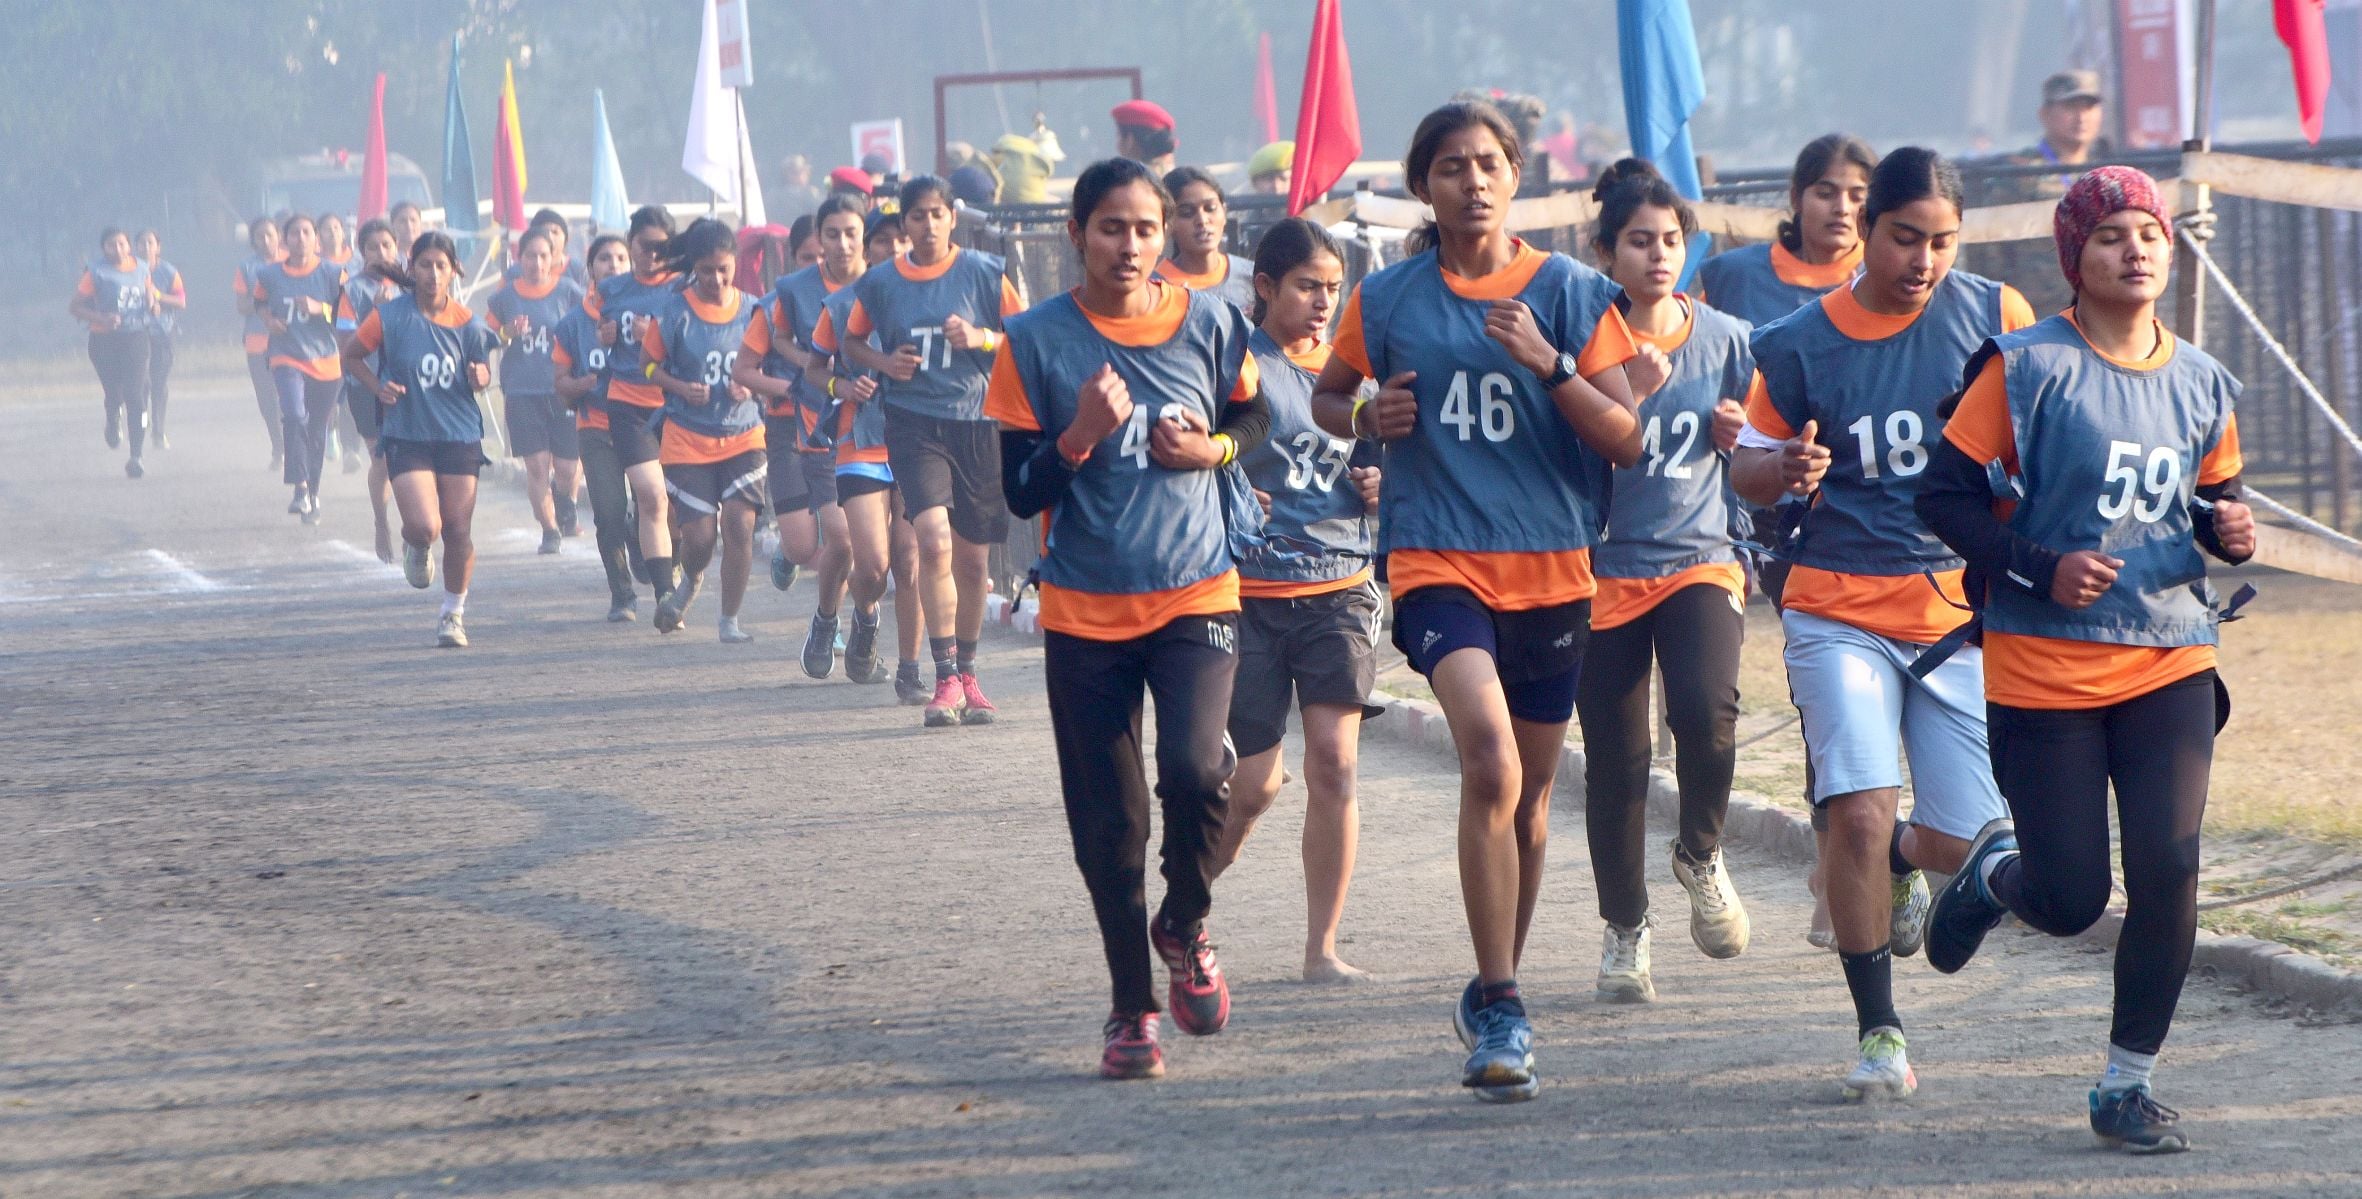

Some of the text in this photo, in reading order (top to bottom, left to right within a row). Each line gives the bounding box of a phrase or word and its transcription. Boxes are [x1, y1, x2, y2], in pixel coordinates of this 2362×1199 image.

[421, 352, 456, 389] 98
[910, 326, 953, 371] 77
[1439, 370, 1515, 443] 46
[1288, 431, 1350, 493] 35
[1642, 410, 1699, 479] 42
[1848, 409, 1929, 479] 18
[2097, 440, 2181, 523] 59
